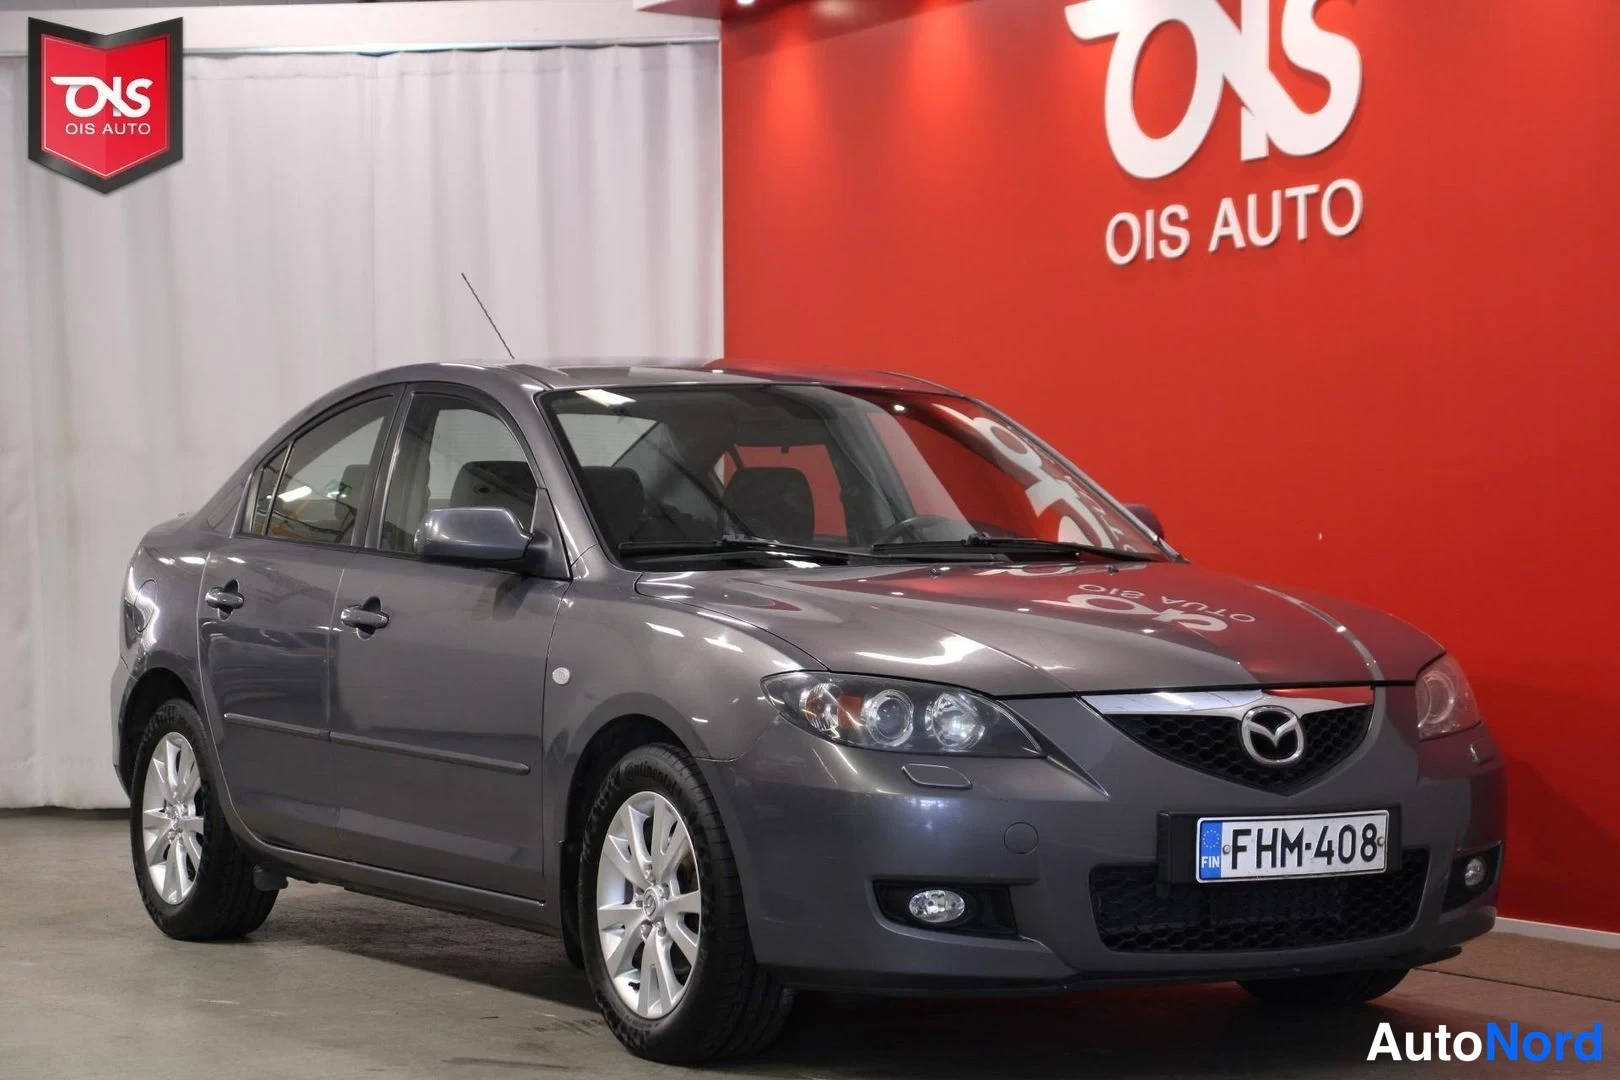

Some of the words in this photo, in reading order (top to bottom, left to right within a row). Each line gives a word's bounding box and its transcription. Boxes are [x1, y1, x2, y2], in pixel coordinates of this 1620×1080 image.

[1105, 204, 1190, 265] OIS
[1208, 178, 1363, 252] AUTO
[1201, 855, 1220, 869] FIN
[1231, 822, 1378, 870] FHM-408
